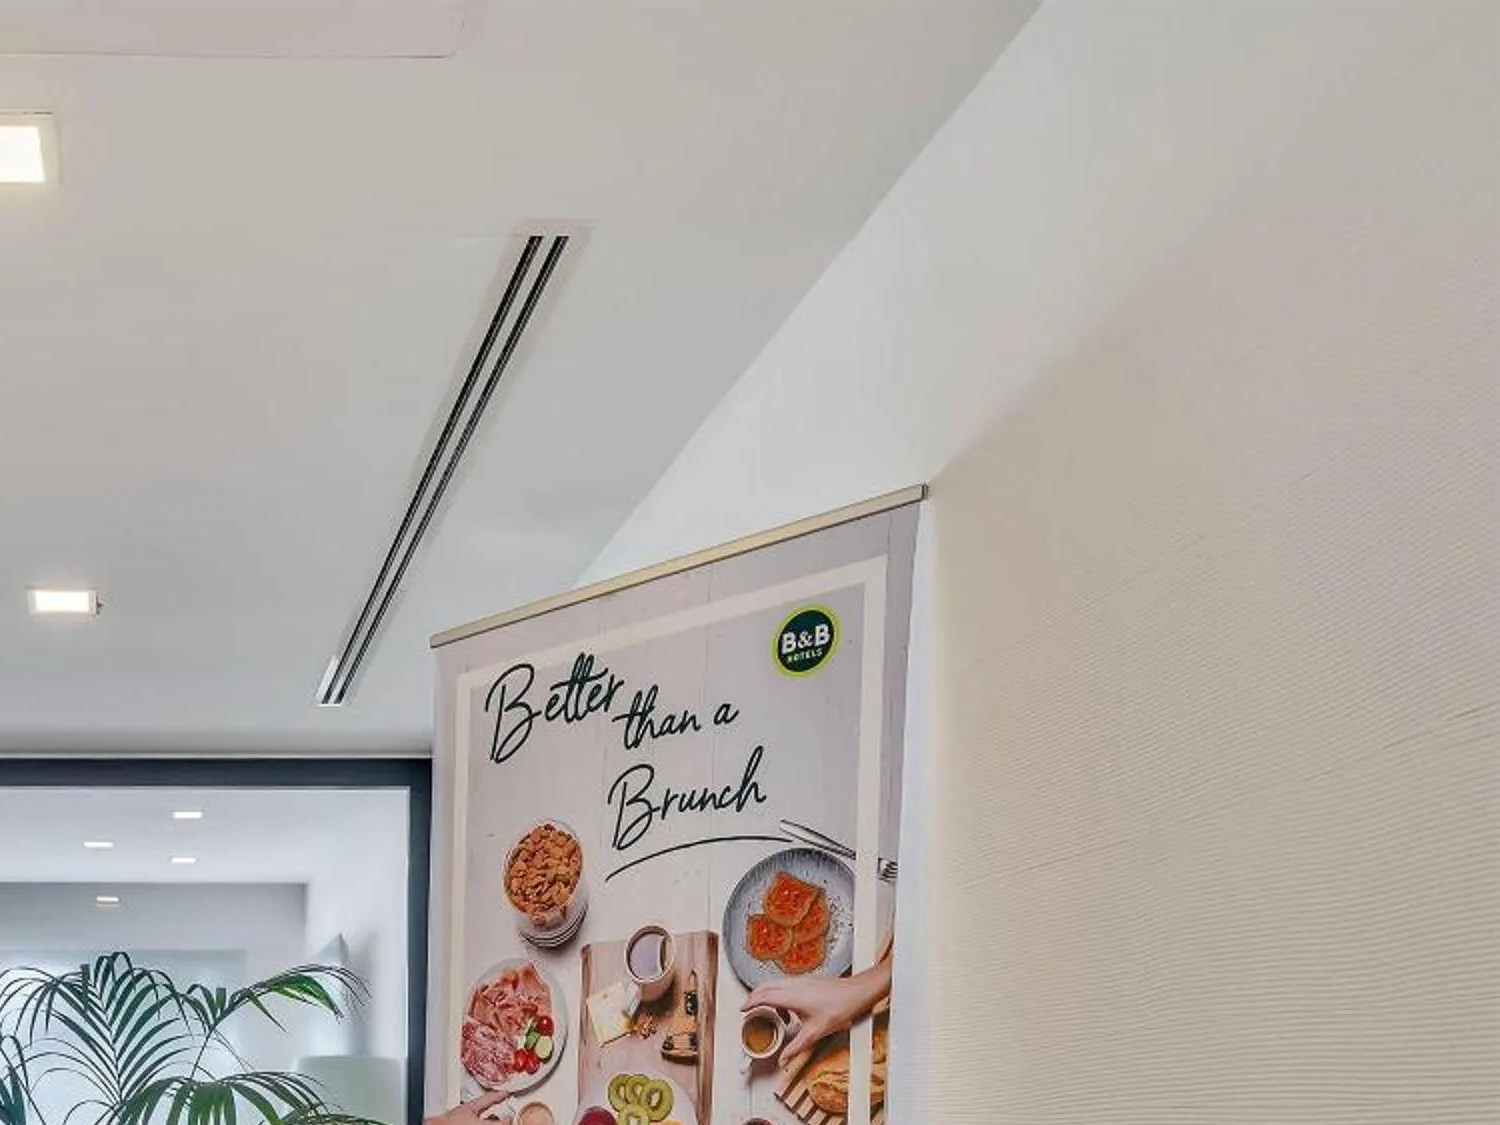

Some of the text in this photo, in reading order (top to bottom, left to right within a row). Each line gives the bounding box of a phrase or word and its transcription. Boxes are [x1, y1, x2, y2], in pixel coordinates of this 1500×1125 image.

[781, 624, 831, 655] B&B
[787, 647, 823, 663] HOTELS
[486, 652, 741, 764] Better than a
[607, 745, 768, 851] Brunch
